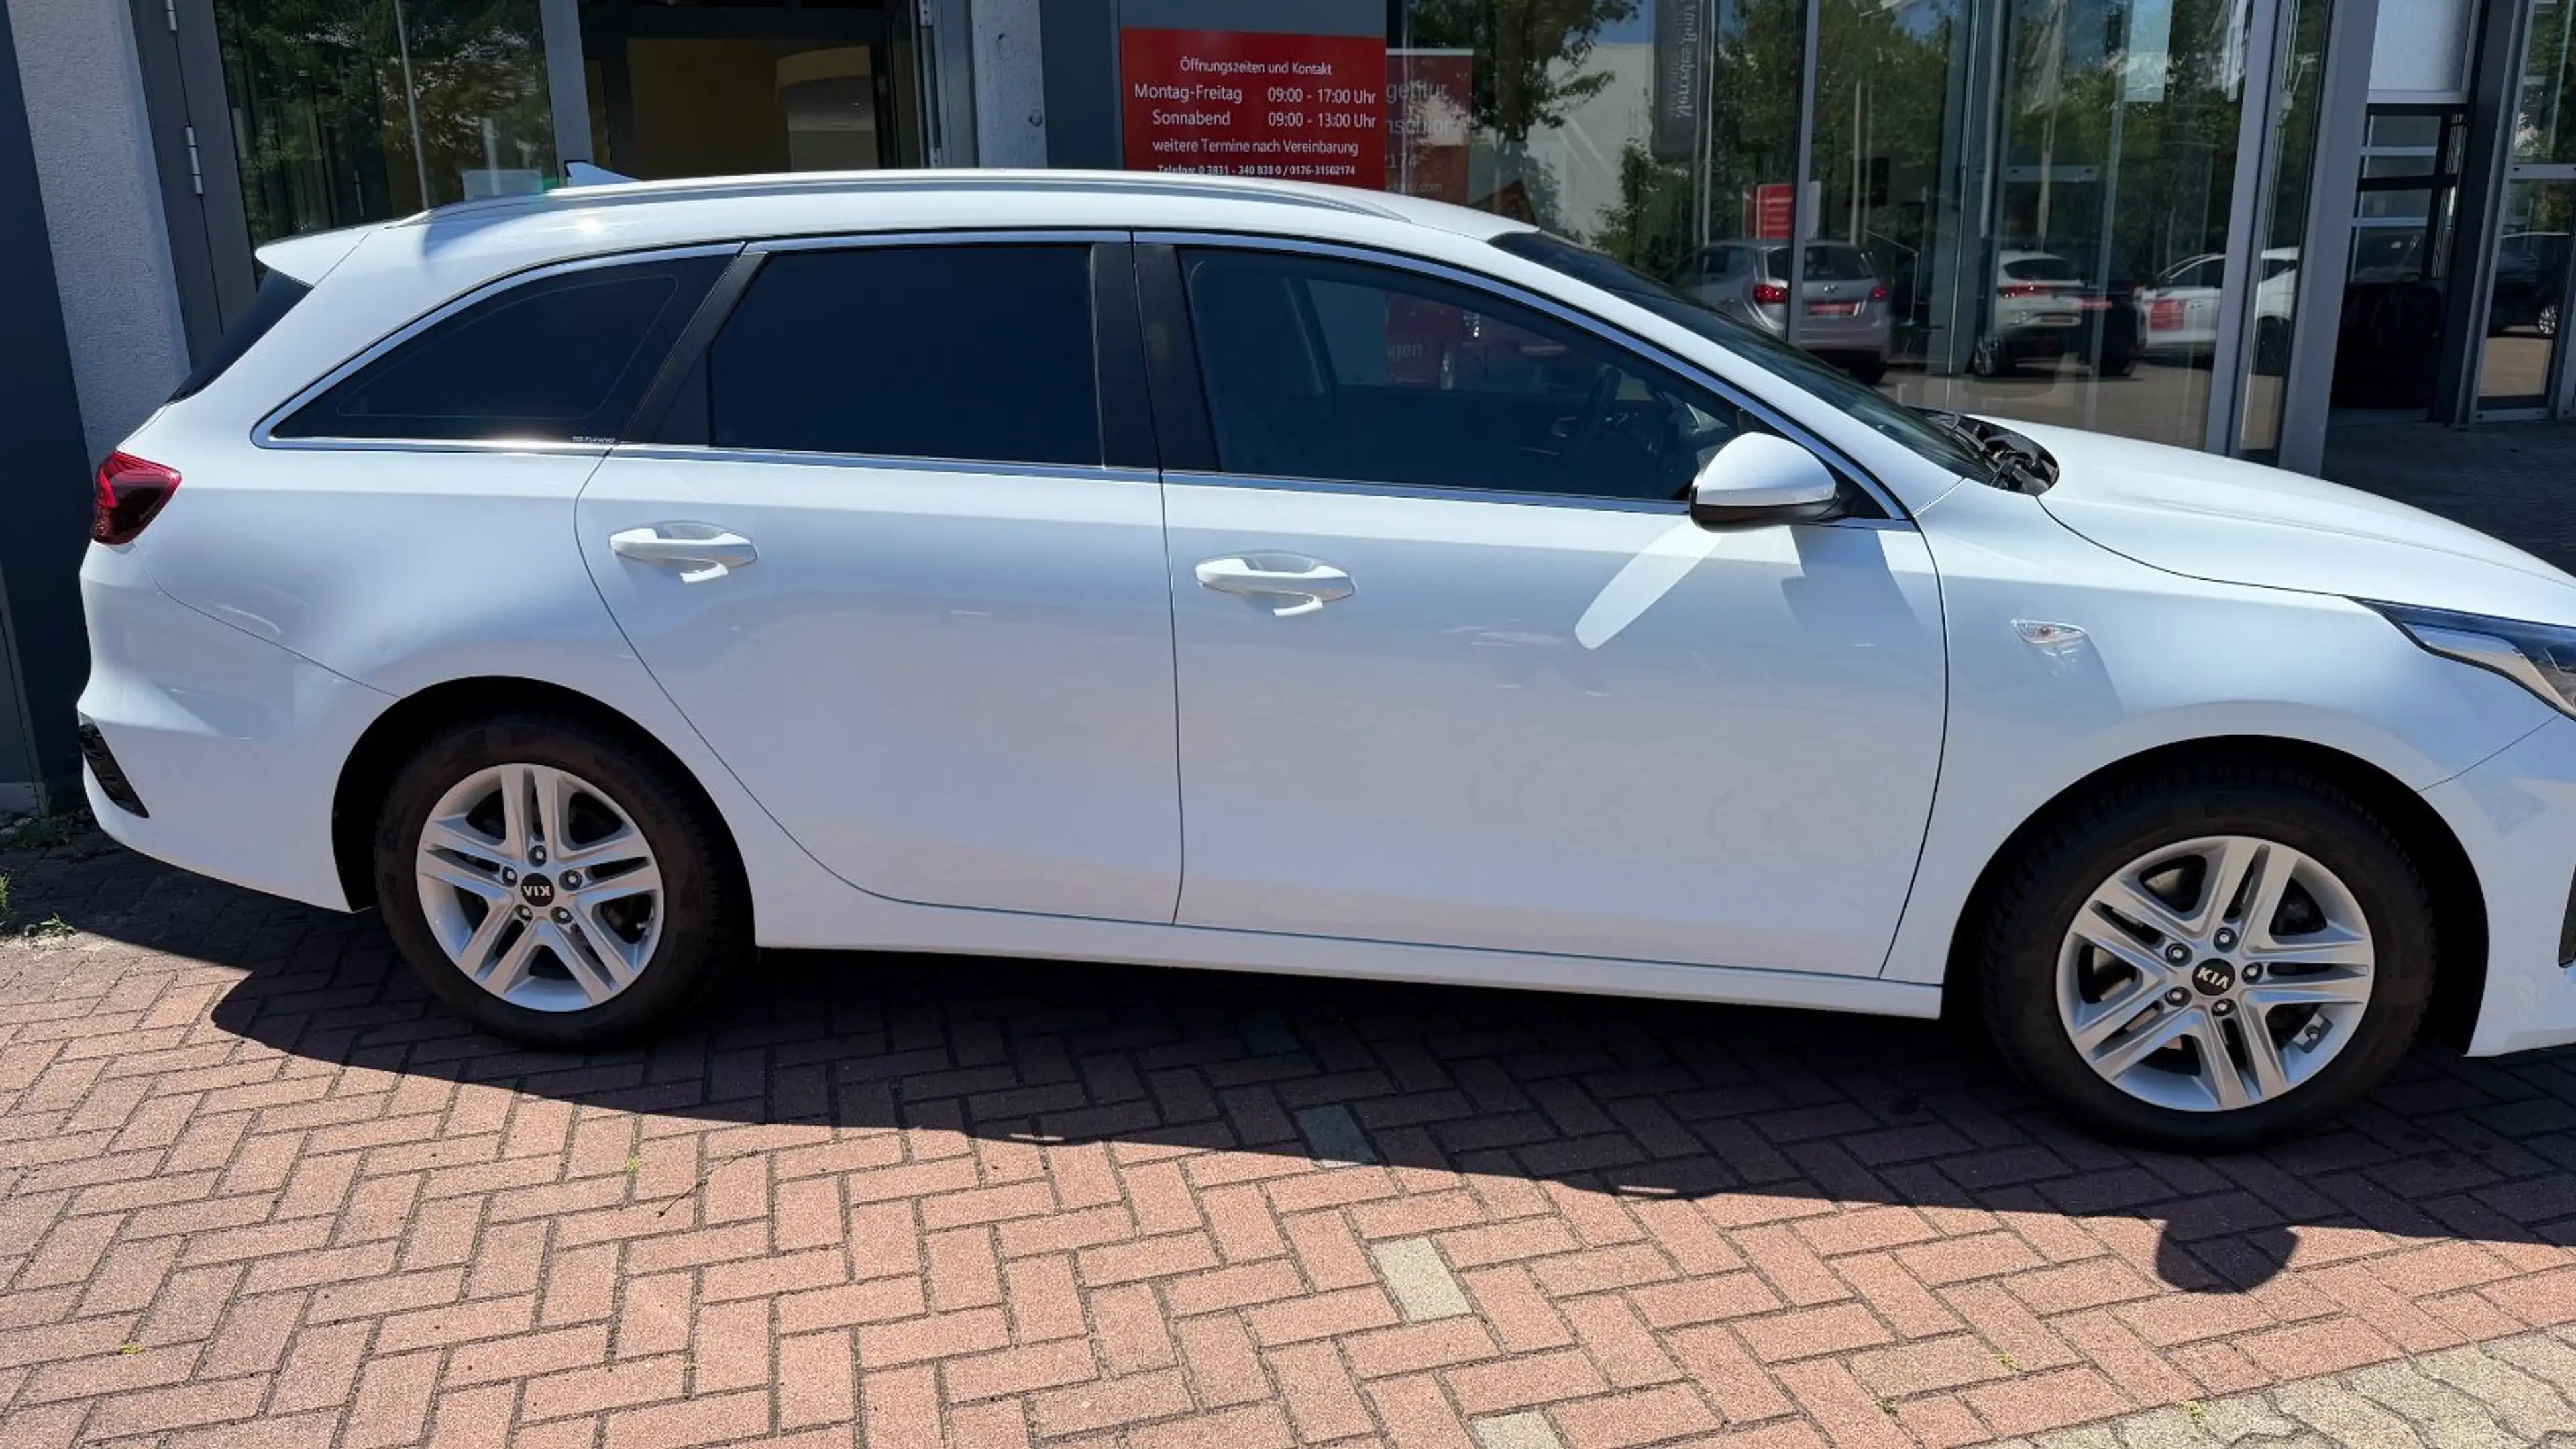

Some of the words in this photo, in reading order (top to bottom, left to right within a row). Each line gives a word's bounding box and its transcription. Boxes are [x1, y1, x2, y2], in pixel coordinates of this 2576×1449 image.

[1180, 56, 1265, 75] Öffnungszeiten
[1269, 62, 1289, 74] und
[1292, 62, 1332, 76] Kontakt
[1134, 83, 1242, 104] Montag-Freitag
[1267, 87, 1303, 103] 09:00
[1318, 88, 1350, 104] 17:00
[1354, 89, 1376, 104] Uhr
[1152, 109, 1231, 125] Sonnabend
[1268, 111, 1303, 127] 09:00
[1318, 112, 1350, 128] 13:00
[1354, 113, 1376, 129] Uhr
[1152, 138, 1199, 152] weitere
[1201, 138, 1250, 153] Termine
[1252, 138, 1281, 153] nach
[1283, 138, 1358, 157] Vereinbarung
[1238, 165, 1255, 176] 340
[523, 885, 551, 896] KIA
[2197, 967, 2229, 989] KIA
